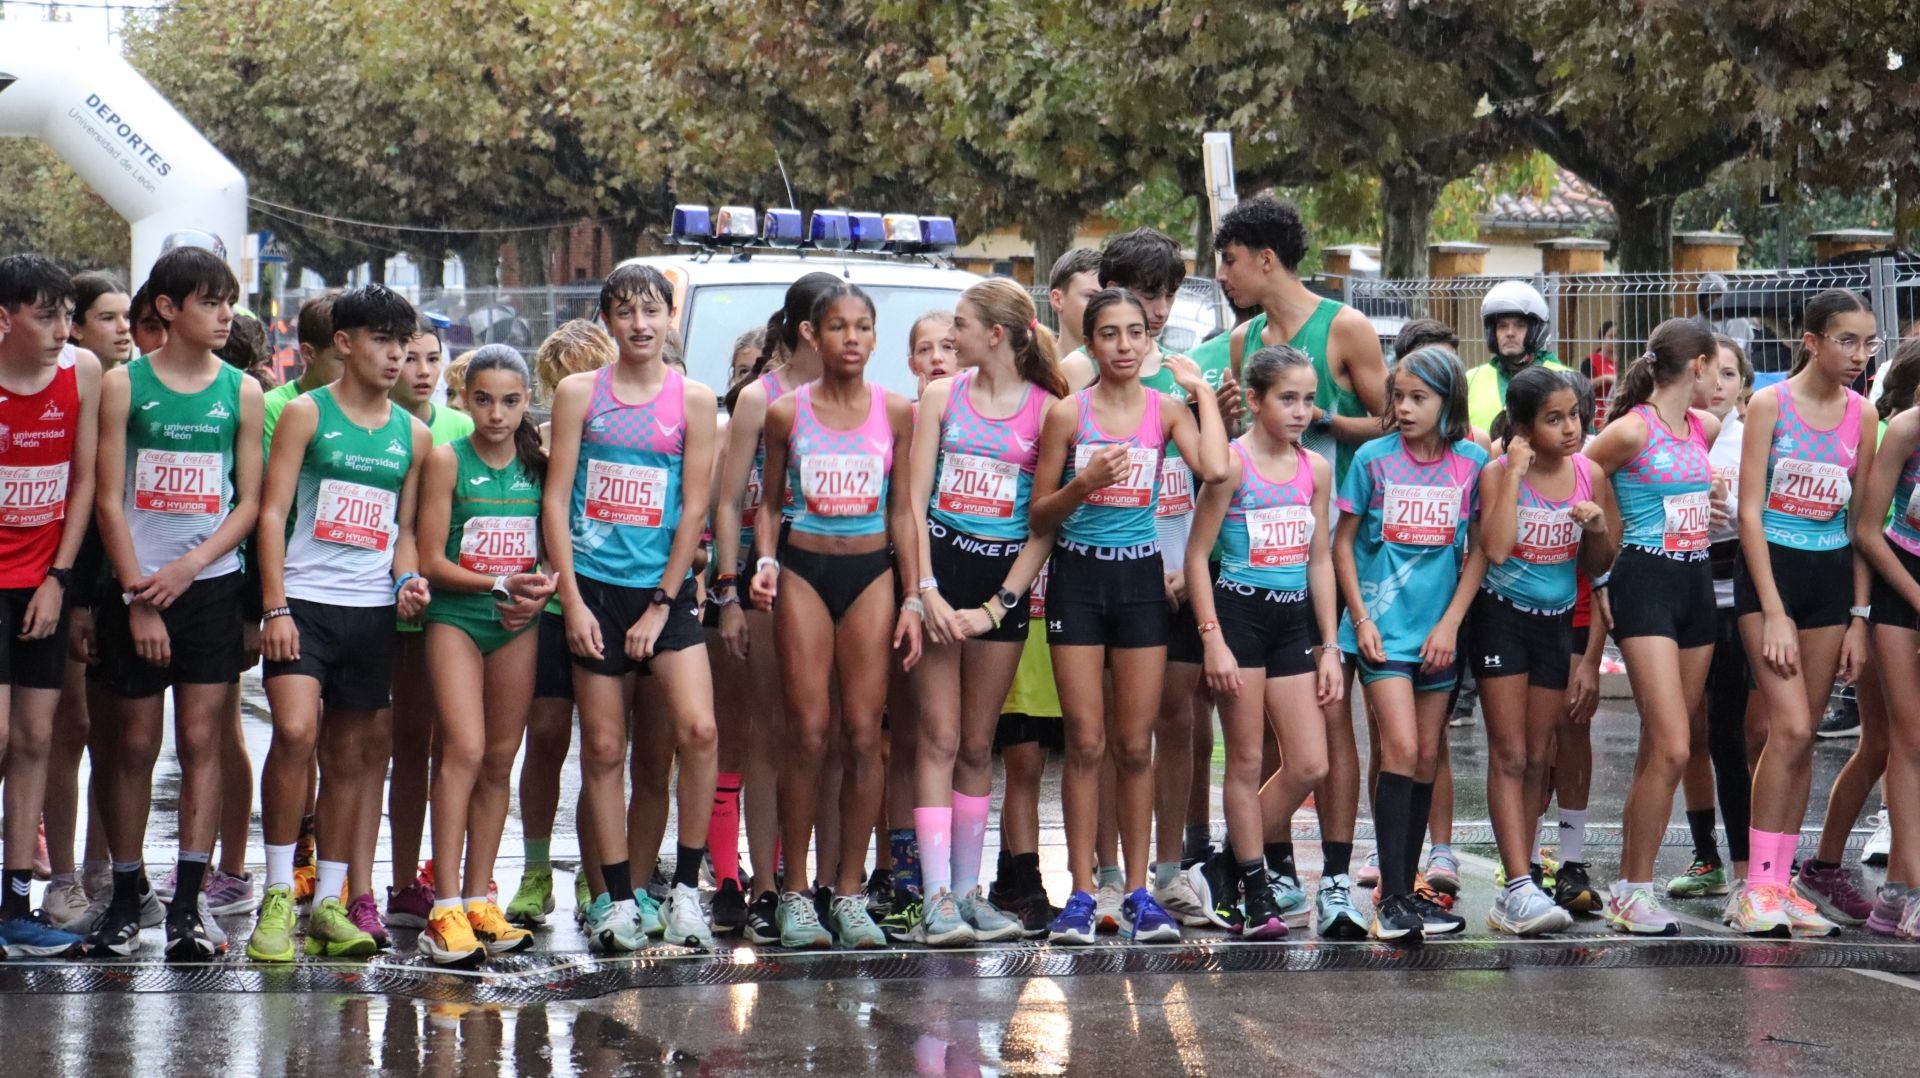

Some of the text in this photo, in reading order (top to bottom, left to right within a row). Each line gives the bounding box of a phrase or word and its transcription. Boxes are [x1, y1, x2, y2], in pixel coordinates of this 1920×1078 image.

[85, 93, 171, 176] DEPORTES
[68, 108, 156, 193] Universidad de León
[13, 429, 64, 440] universidad
[164, 423, 219, 433] universidad
[171, 431, 192, 440] león
[20, 440, 39, 448] león
[345, 454, 400, 470] universidad
[352, 463, 372, 472] león
[154, 466, 204, 493] 2021
[815, 471, 869, 494] 2042
[951, 469, 1003, 498] 2047
[1784, 473, 1838, 502] 2044
[3, 480, 57, 506] 2022
[598, 476, 652, 506] 2005
[1104, 496, 1140, 504] HYUNDAI
[167, 501, 206, 510] HYUNDAI
[334, 497, 383, 528] 2018
[831, 503, 869, 513] HYUNDAI
[963, 504, 1000, 514] HYUNDAI
[1397, 500, 1449, 526] 2045
[1797, 506, 1834, 517] HYUNDAI
[612, 511, 649, 522] HYUNDAI
[346, 532, 378, 545] HYUNDAI
[475, 531, 525, 556] 2063
[1262, 520, 1306, 548] 2079
[1412, 533, 1447, 542] HYUNDAI
[1522, 521, 1574, 547] 2038
[1764, 526, 1808, 545] PRO
[952, 535, 1002, 557] NIKE
[1536, 552, 1568, 561] HYUNDAI
[1215, 577, 1305, 603] PRO NIKE
